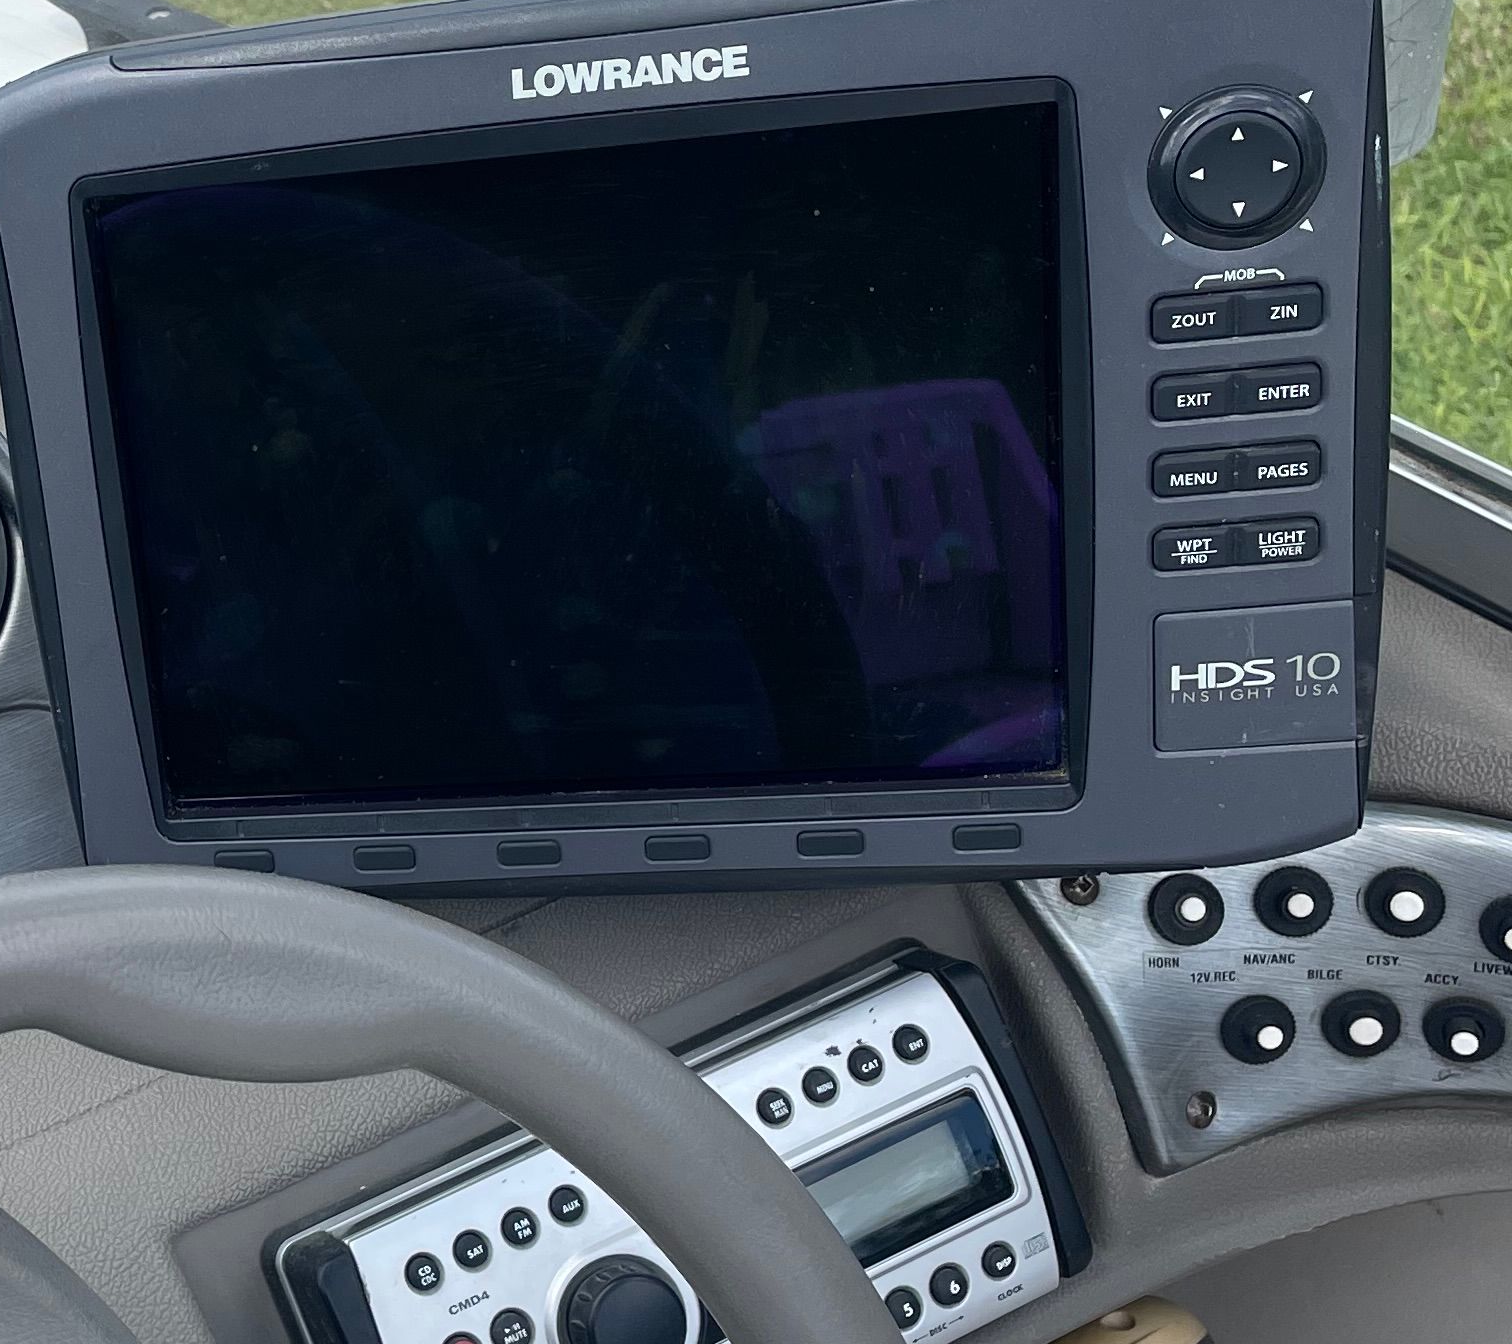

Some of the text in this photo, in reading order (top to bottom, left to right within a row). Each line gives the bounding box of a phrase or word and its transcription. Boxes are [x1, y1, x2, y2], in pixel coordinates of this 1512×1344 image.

[510, 44, 751, 100] LOWRANCE
[1223, 267, 1256, 282] MOB
[1171, 304, 1298, 328] ZOUT ZIN
[1176, 384, 1310, 408] EXIT ENTER
[1169, 462, 1309, 487] MENU PAGES
[1258, 530, 1306, 545] LIGHT
[1176, 538, 1213, 553] WPT
[1261, 545, 1303, 558] POWER
[1180, 553, 1208, 564] FIND
[1170, 651, 1341, 692] HDS 10
[1171, 682, 1339, 704] INSIGHT USA
[1148, 956, 1180, 969] HORN
[1243, 953, 1296, 966] NAV/ANC
[1307, 969, 1344, 981] BILGE
[861, 1058, 880, 1073] CAT
[561, 1198, 581, 1214] AUX
[513, 1217, 531, 1231] AM
[517, 1226, 533, 1239] FM
[466, 1244, 484, 1259] SAT
[418, 1265, 432, 1277] CD
[995, 1256, 1013, 1271] DISP
[421, 1272, 438, 1286] CDC
[949, 1279, 961, 1295] 6
[997, 1283, 1024, 1302] CLOCK
[448, 1290, 491, 1316] CMD4
[902, 1302, 914, 1318] 5
[929, 1321, 948, 1337] DISC
